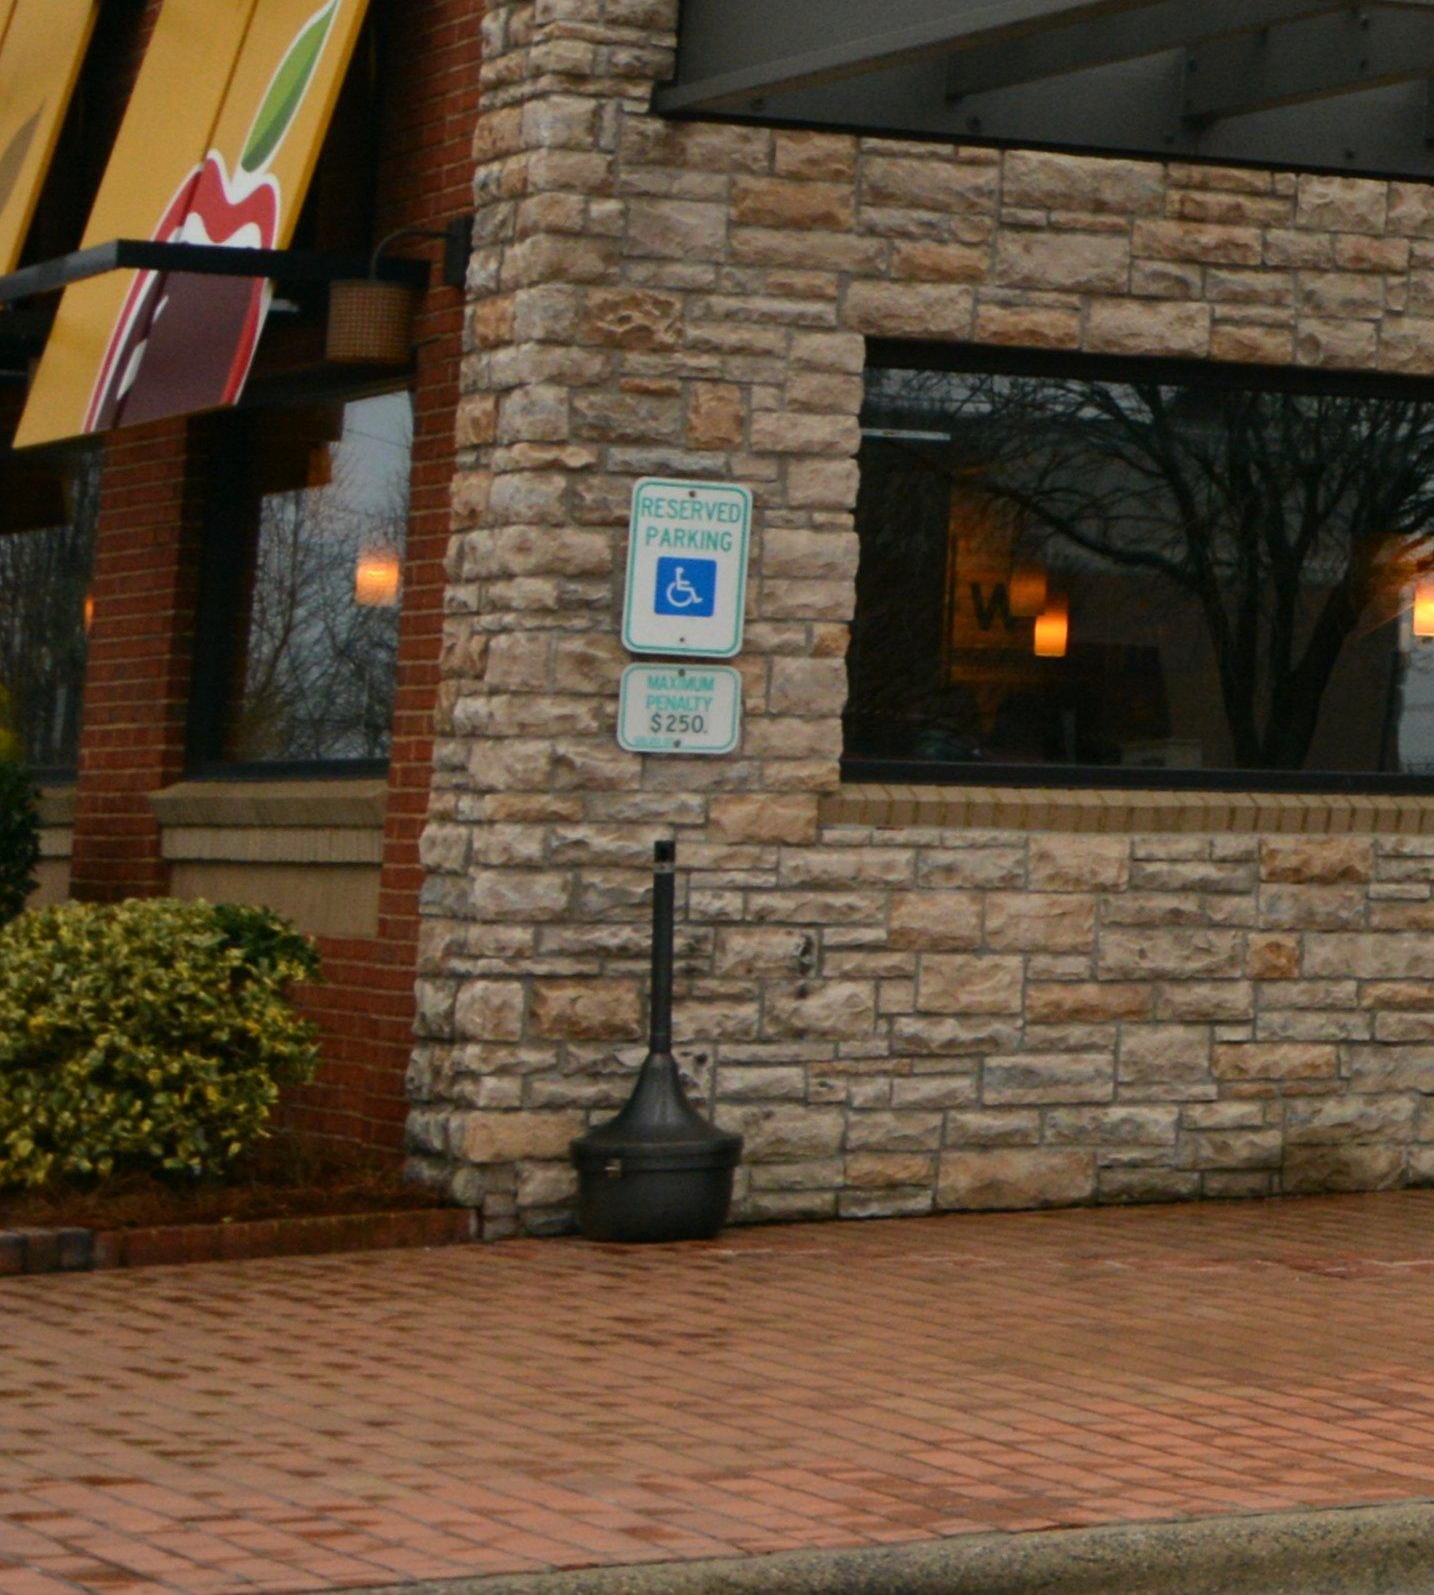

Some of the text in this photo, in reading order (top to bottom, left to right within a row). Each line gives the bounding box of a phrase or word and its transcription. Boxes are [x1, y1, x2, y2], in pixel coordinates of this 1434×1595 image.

[640, 497, 741, 523] RESERVED
[645, 527, 732, 552] PARKING
[646, 676, 714, 692] MAXIMUM
[646, 695, 712, 712] PENALTY
